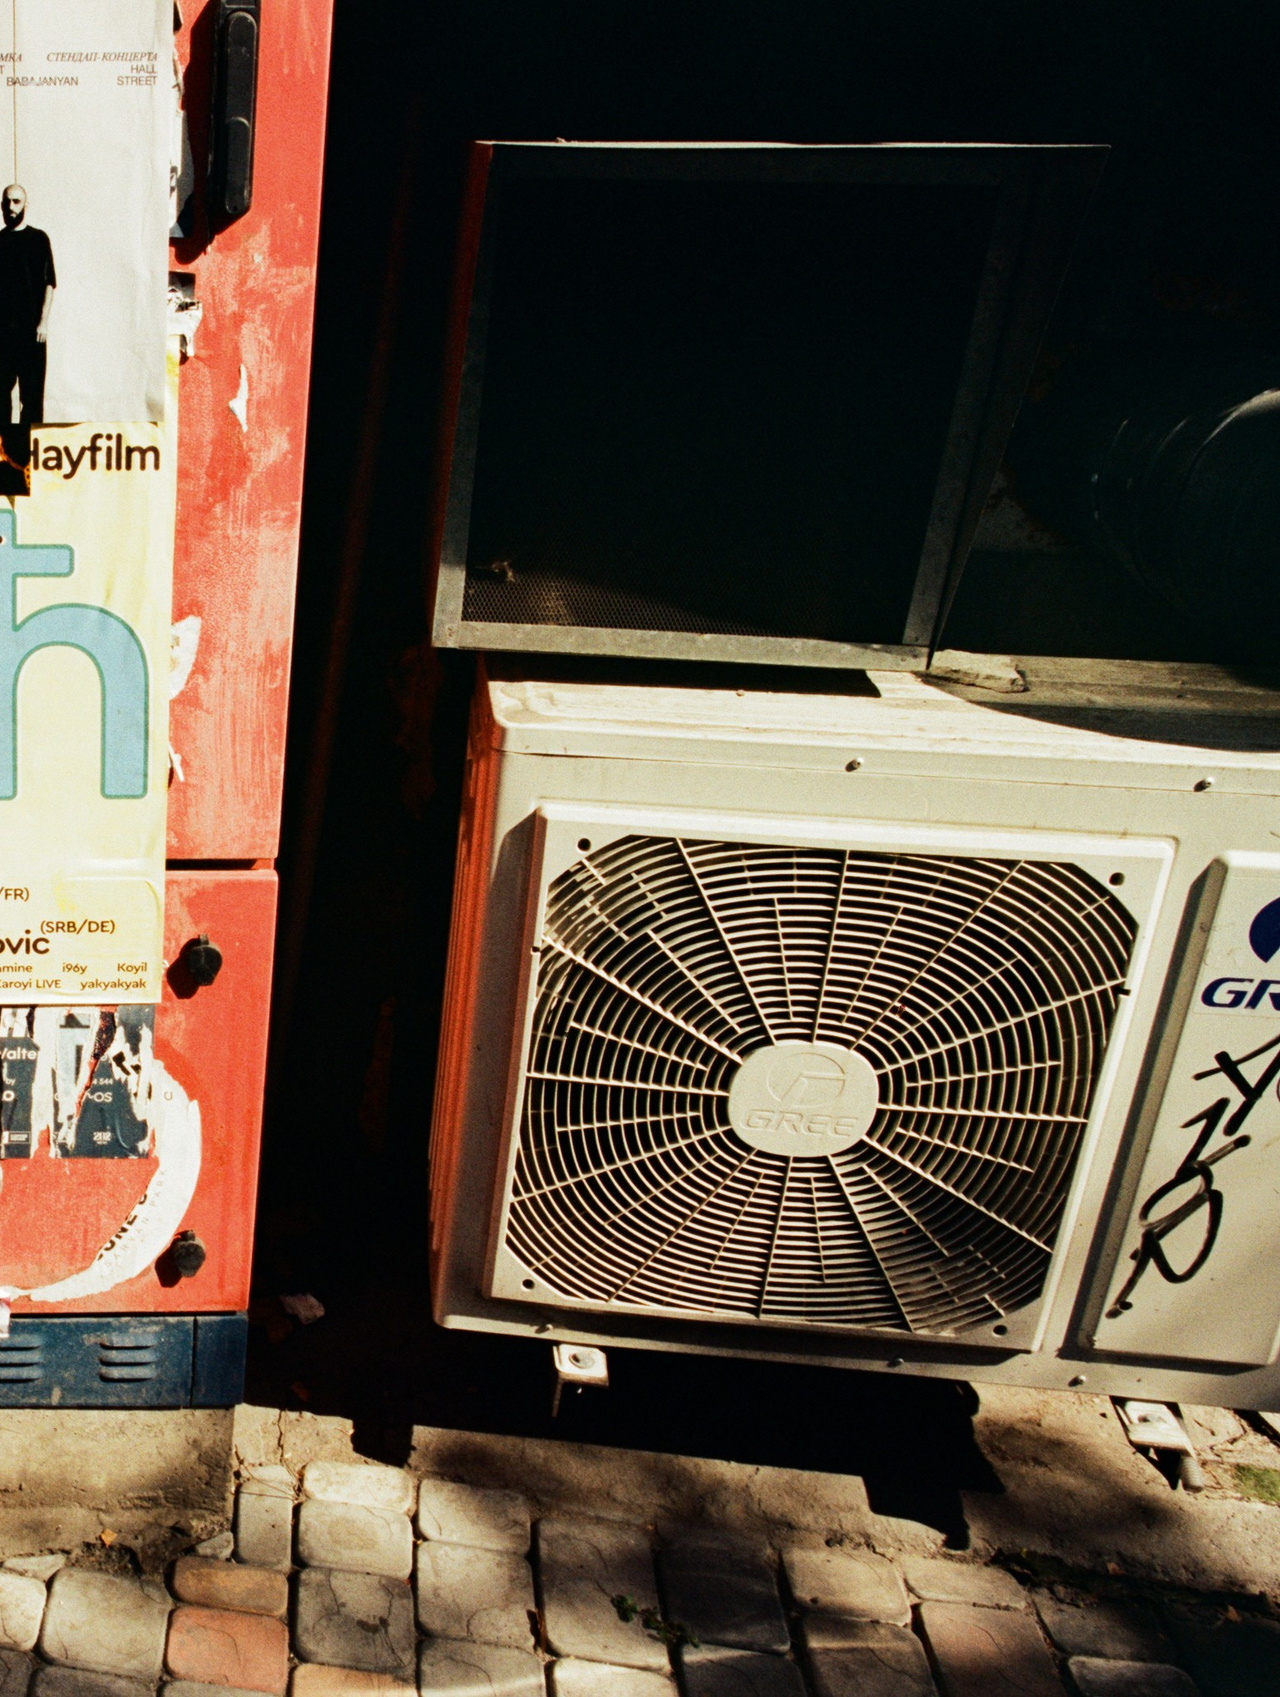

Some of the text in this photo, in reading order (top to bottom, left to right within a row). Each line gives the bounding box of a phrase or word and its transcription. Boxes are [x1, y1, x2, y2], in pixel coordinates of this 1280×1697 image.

[46, 51, 158, 63] СТЕНДАП-КОНЦЕРТА
[130, 64, 158, 75] HALL
[116, 75, 158, 86] STREET
[40, 919, 116, 935] (SRB/DE)
[62, 963, 88, 975] i96y
[117, 963, 148, 974] Koyil
[35, 978, 62, 989] LIVE
[79, 977, 147, 991] yakyakyak
[741, 1108, 859, 1138] GREE
